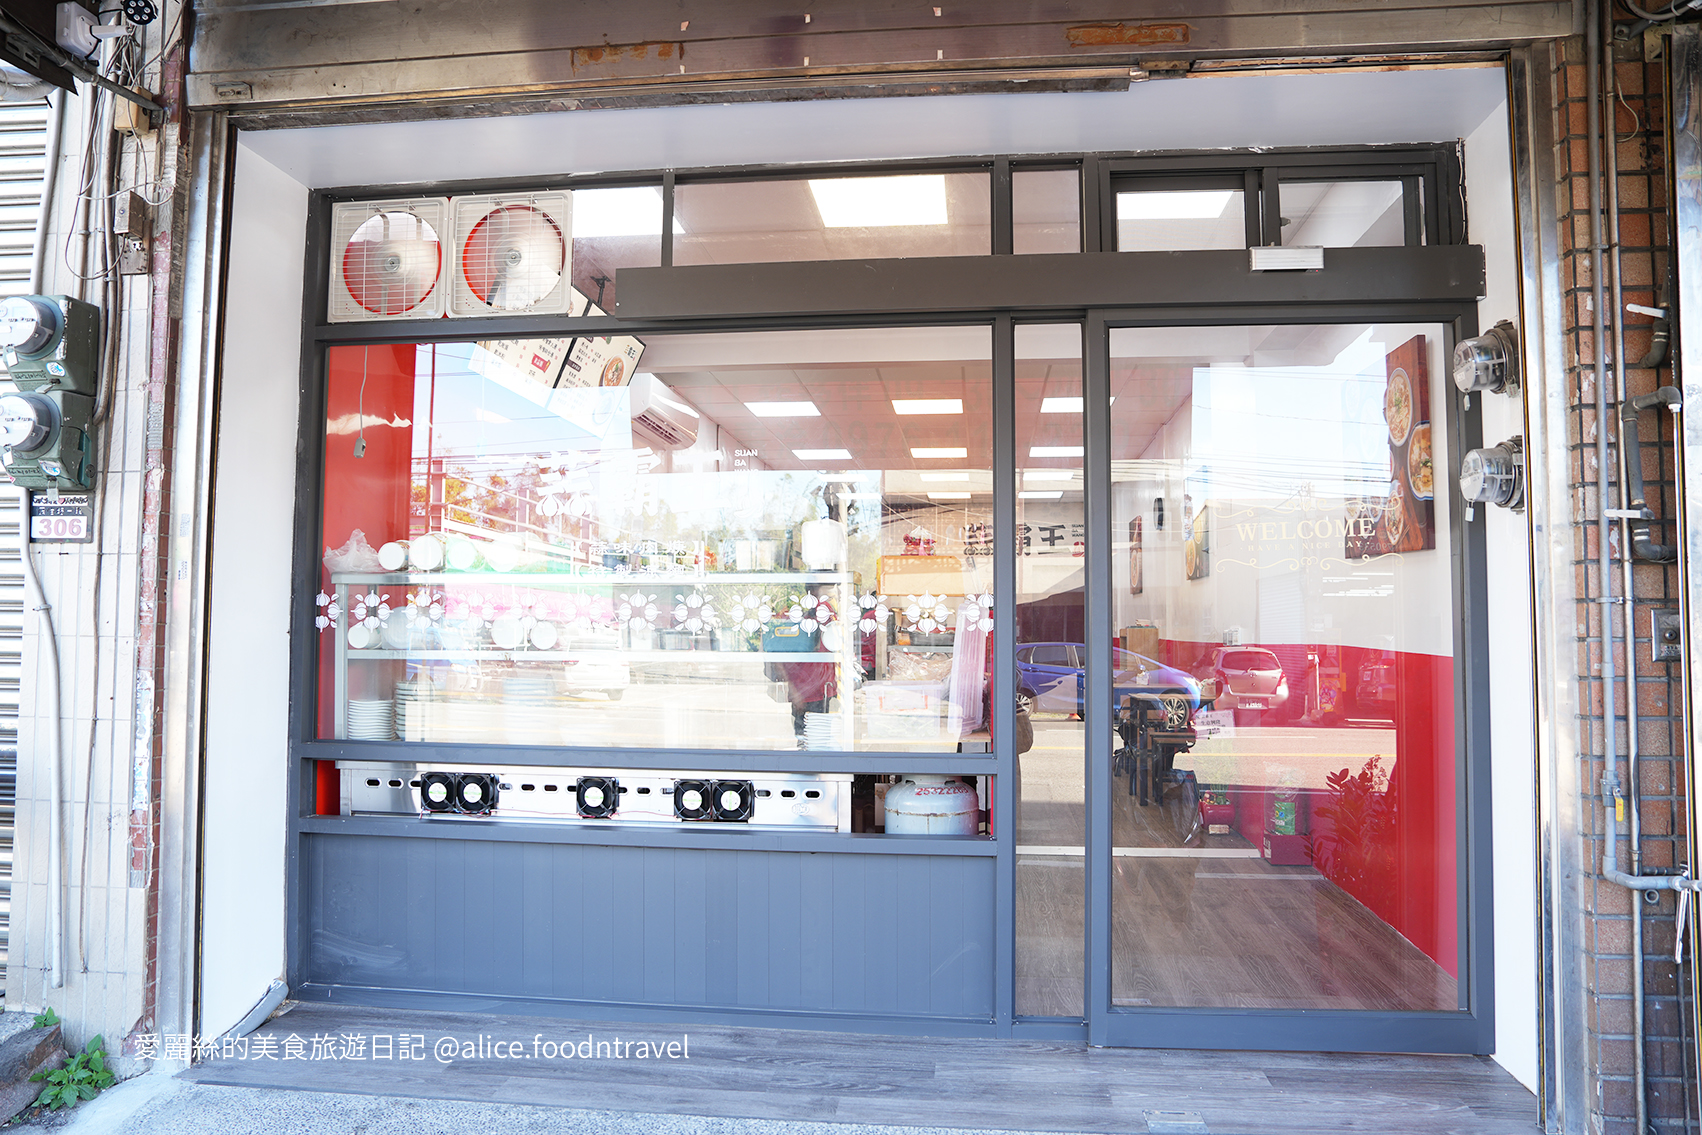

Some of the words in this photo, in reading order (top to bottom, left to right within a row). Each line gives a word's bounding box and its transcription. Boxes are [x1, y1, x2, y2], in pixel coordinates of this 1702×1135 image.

[734, 449, 758, 457] SUAN
[734, 459, 747, 467] BA
[39, 518, 82, 537] 306
[1235, 518, 1376, 542] WELCOME
[1247, 543, 1281, 552] HAVE
[1302, 542, 1331, 550] NICE
[1338, 541, 1363, 549] DAY
